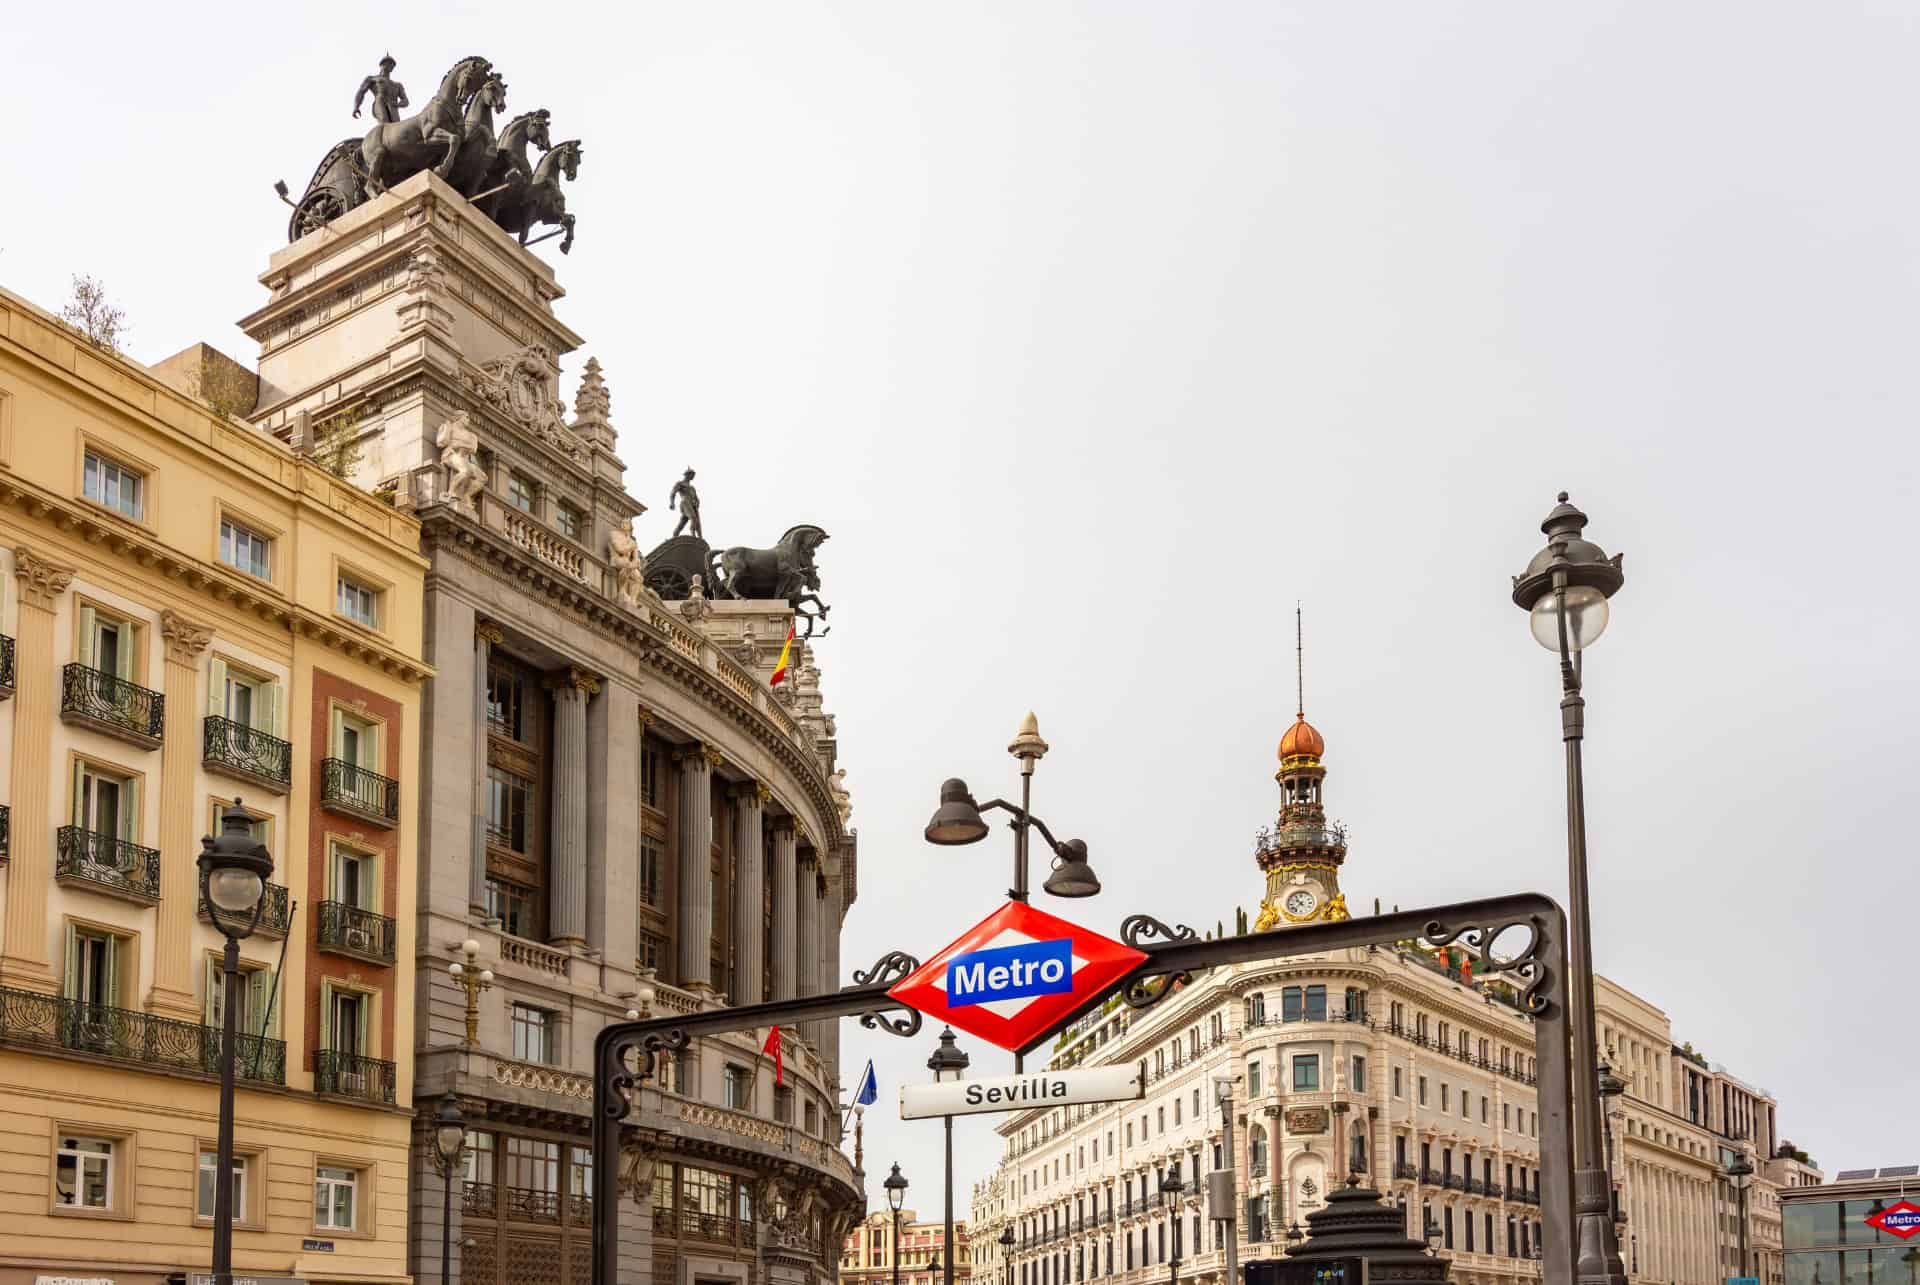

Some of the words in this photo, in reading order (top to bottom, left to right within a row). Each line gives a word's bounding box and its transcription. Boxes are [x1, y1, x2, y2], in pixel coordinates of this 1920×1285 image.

[955, 959, 1064, 995] Metro
[965, 1078, 1067, 1105] Sevilla
[1887, 1215, 1920, 1224] Metro
